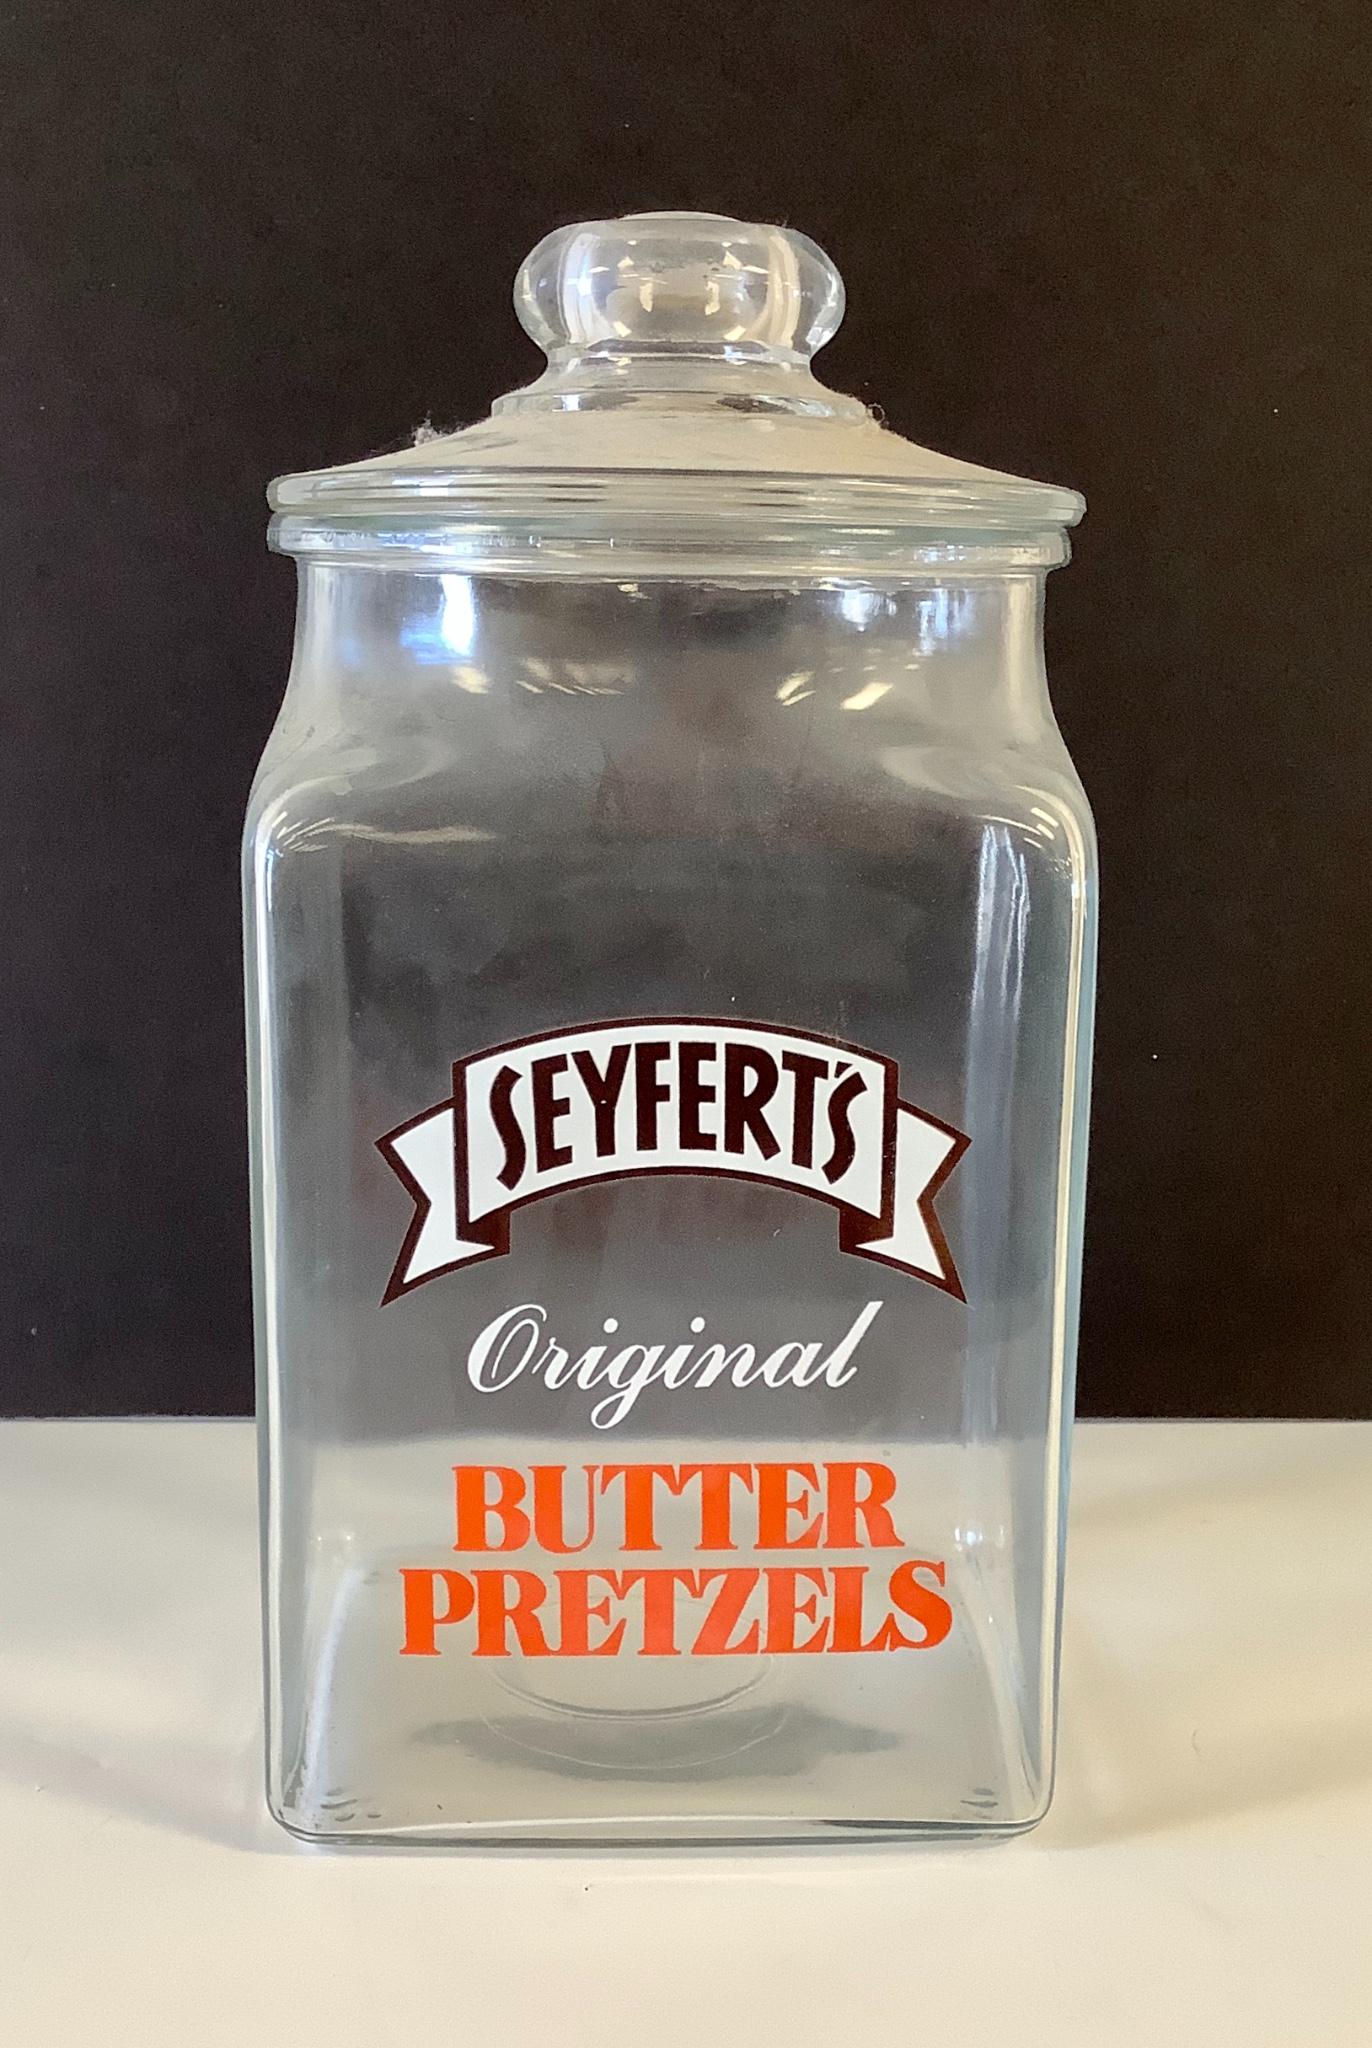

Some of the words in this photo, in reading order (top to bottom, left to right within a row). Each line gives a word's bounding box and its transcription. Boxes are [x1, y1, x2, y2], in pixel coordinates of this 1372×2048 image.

[489, 1041, 868, 1191] SEYFERT'S
[467, 1301, 884, 1429] Original
[451, 1462, 905, 1554] BUTTER
[399, 1560, 953, 1656] PRETZELS
